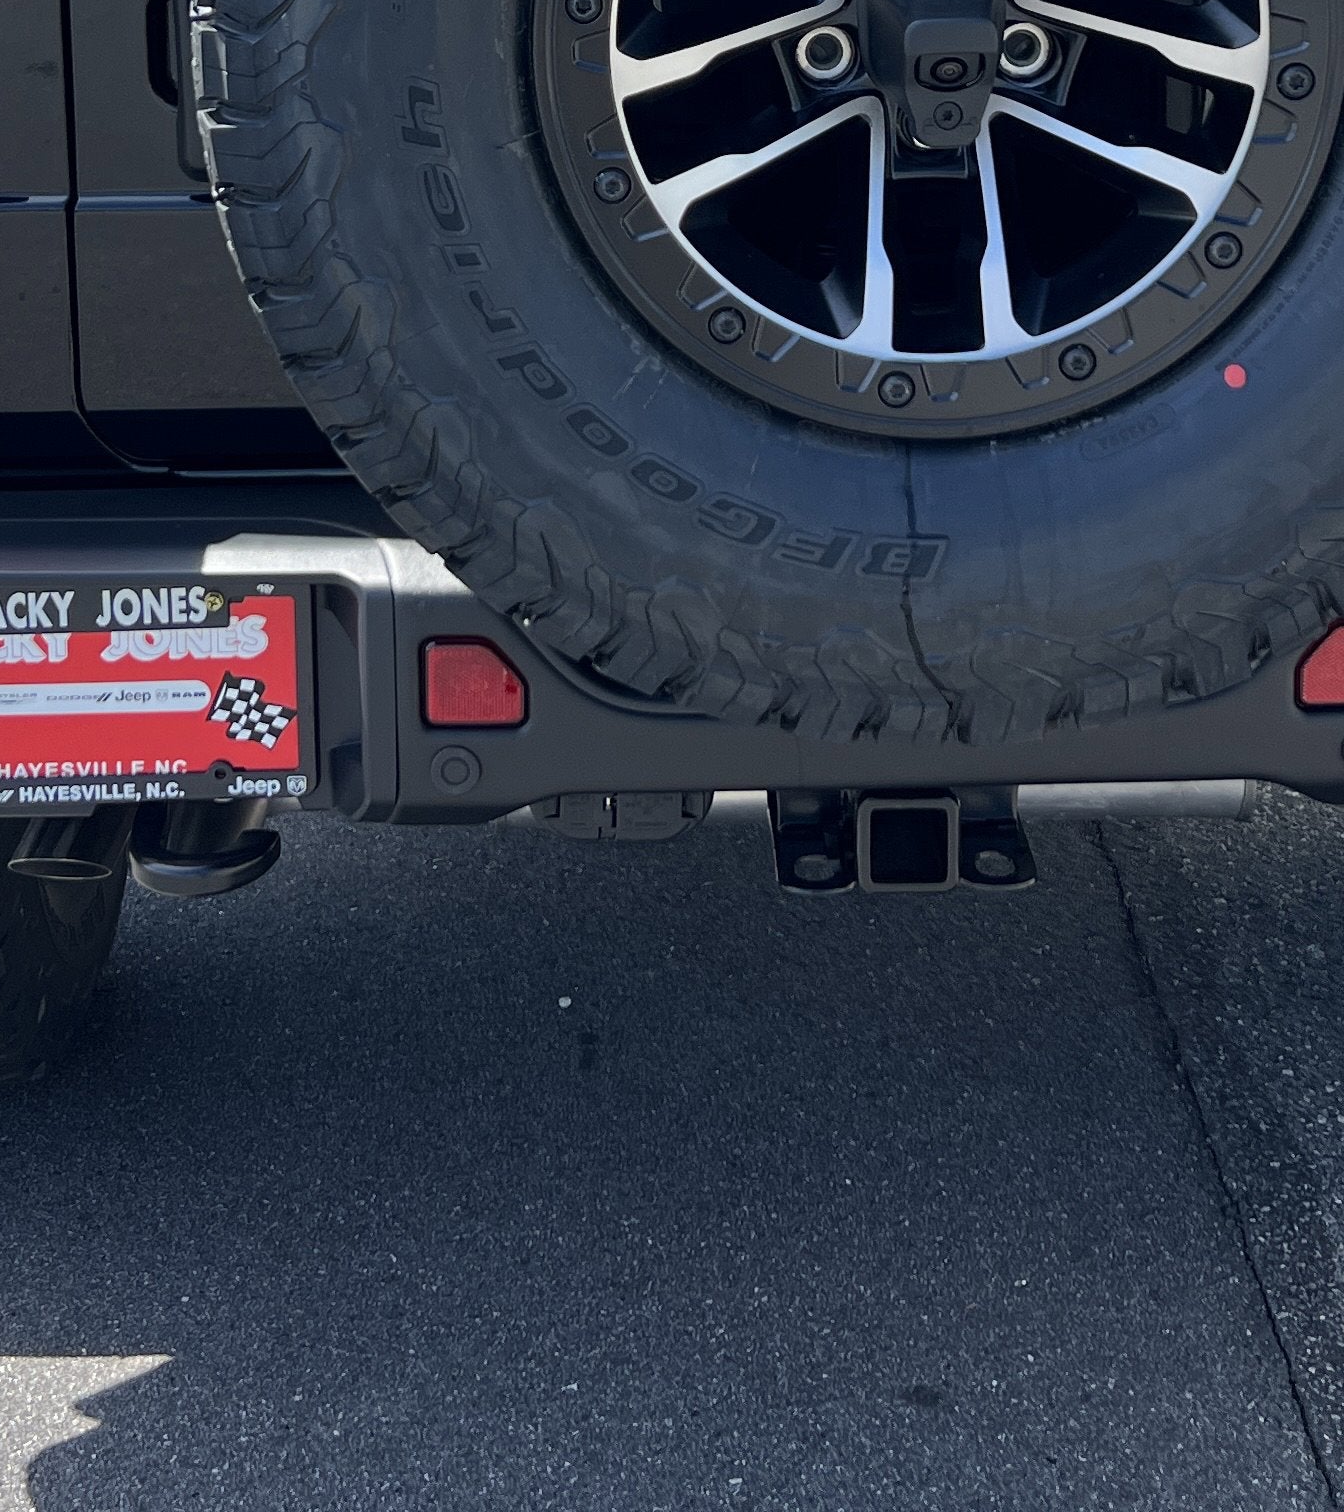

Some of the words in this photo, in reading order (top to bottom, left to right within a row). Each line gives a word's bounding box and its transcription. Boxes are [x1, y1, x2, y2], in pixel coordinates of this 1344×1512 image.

[404, 79, 947, 579] BFGoodrich
[96, 586, 208, 627] JONES
[100, 614, 269, 662] JONES
[115, 689, 151, 703] Jeep
[19, 782, 141, 803] HAYESVILLE,
[146, 781, 185, 800] N.C.
[228, 776, 281, 797] Jeep
